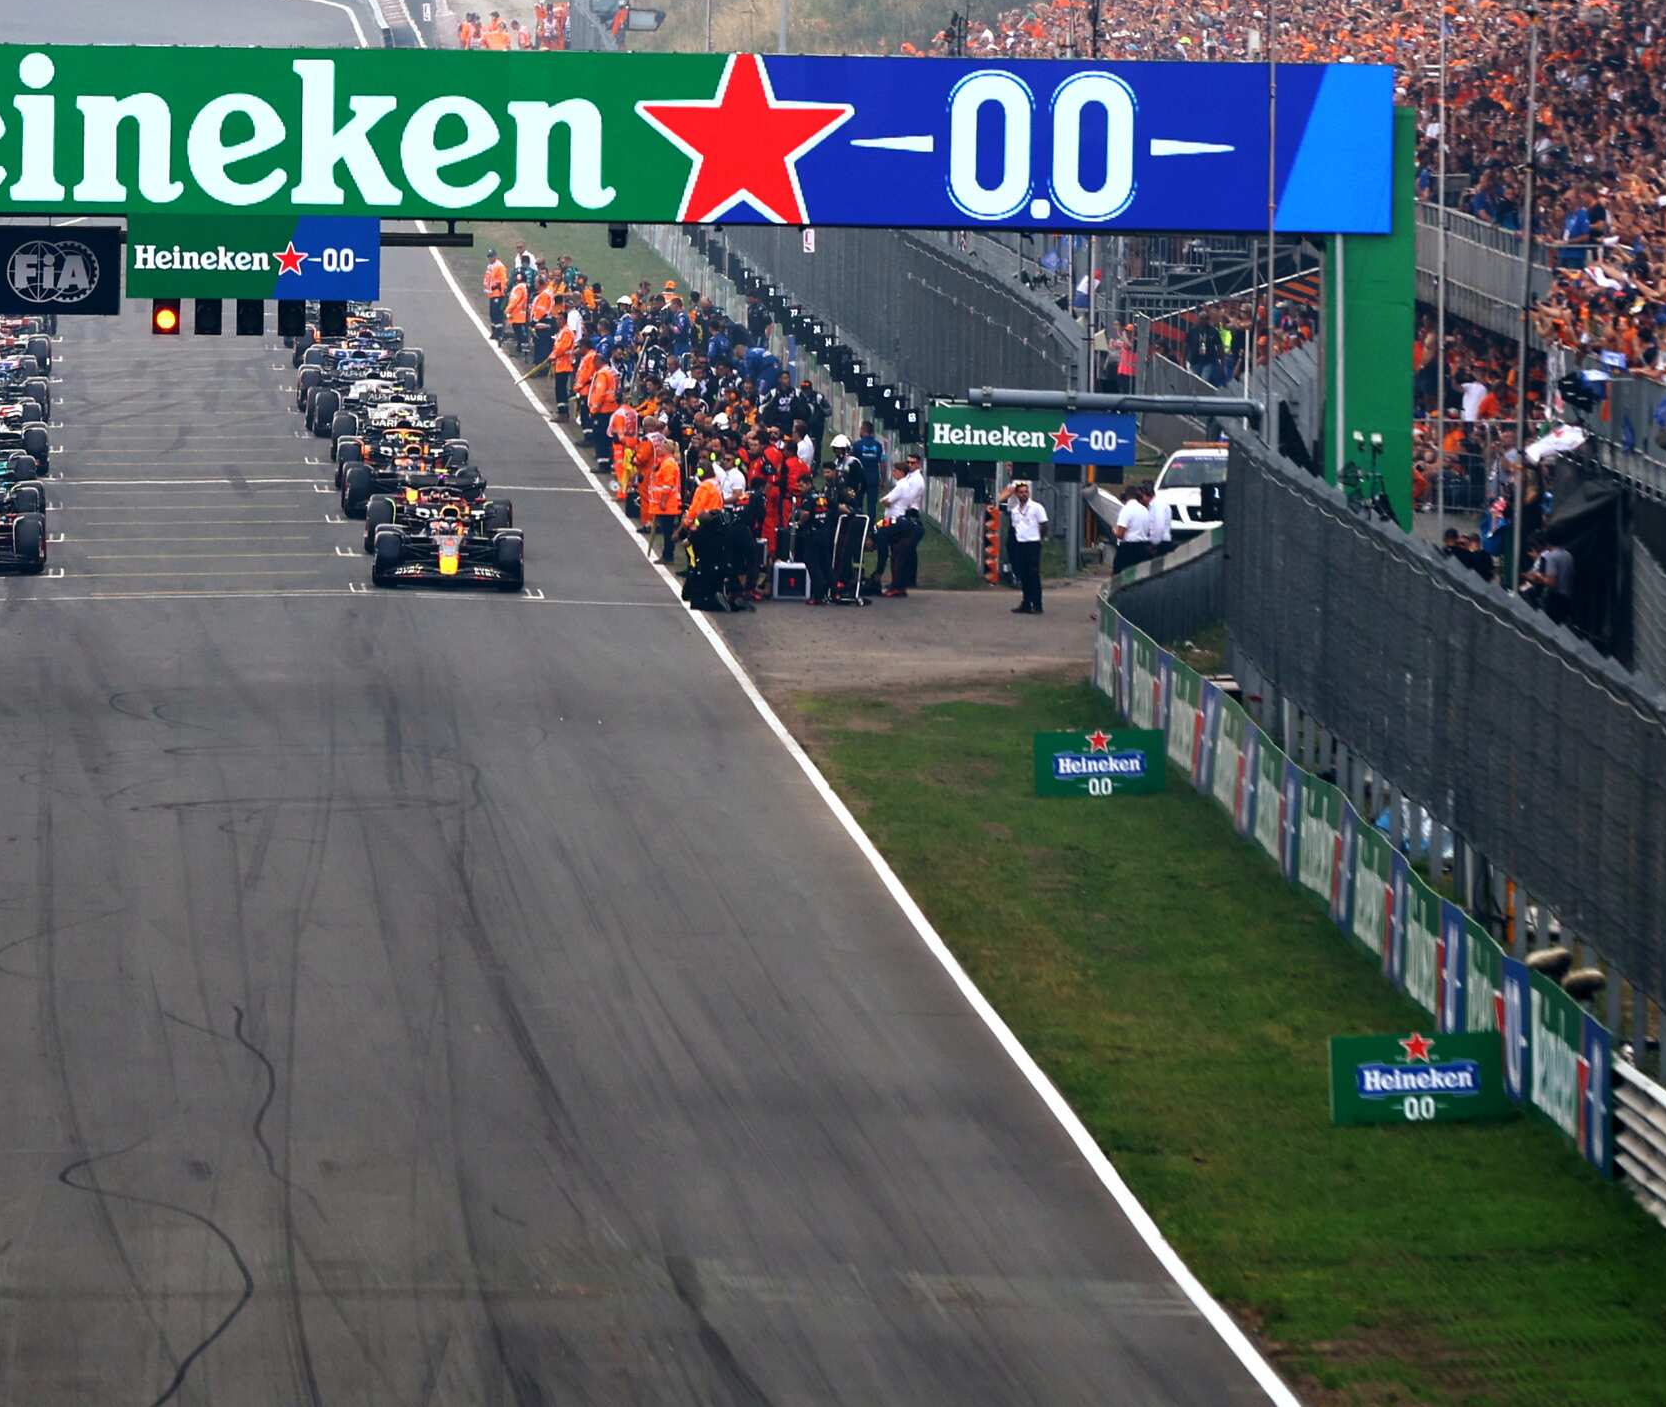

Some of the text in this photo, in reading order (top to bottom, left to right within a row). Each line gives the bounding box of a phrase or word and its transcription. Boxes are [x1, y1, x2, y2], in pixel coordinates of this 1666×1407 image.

[946, 70, 1138, 221] 0.0
[134, 244, 270, 272] Heineken
[932, 423, 1046, 448] Heineken
[1058, 757, 1141, 774] Heineken
[1363, 1068, 1473, 1091] Heineken
